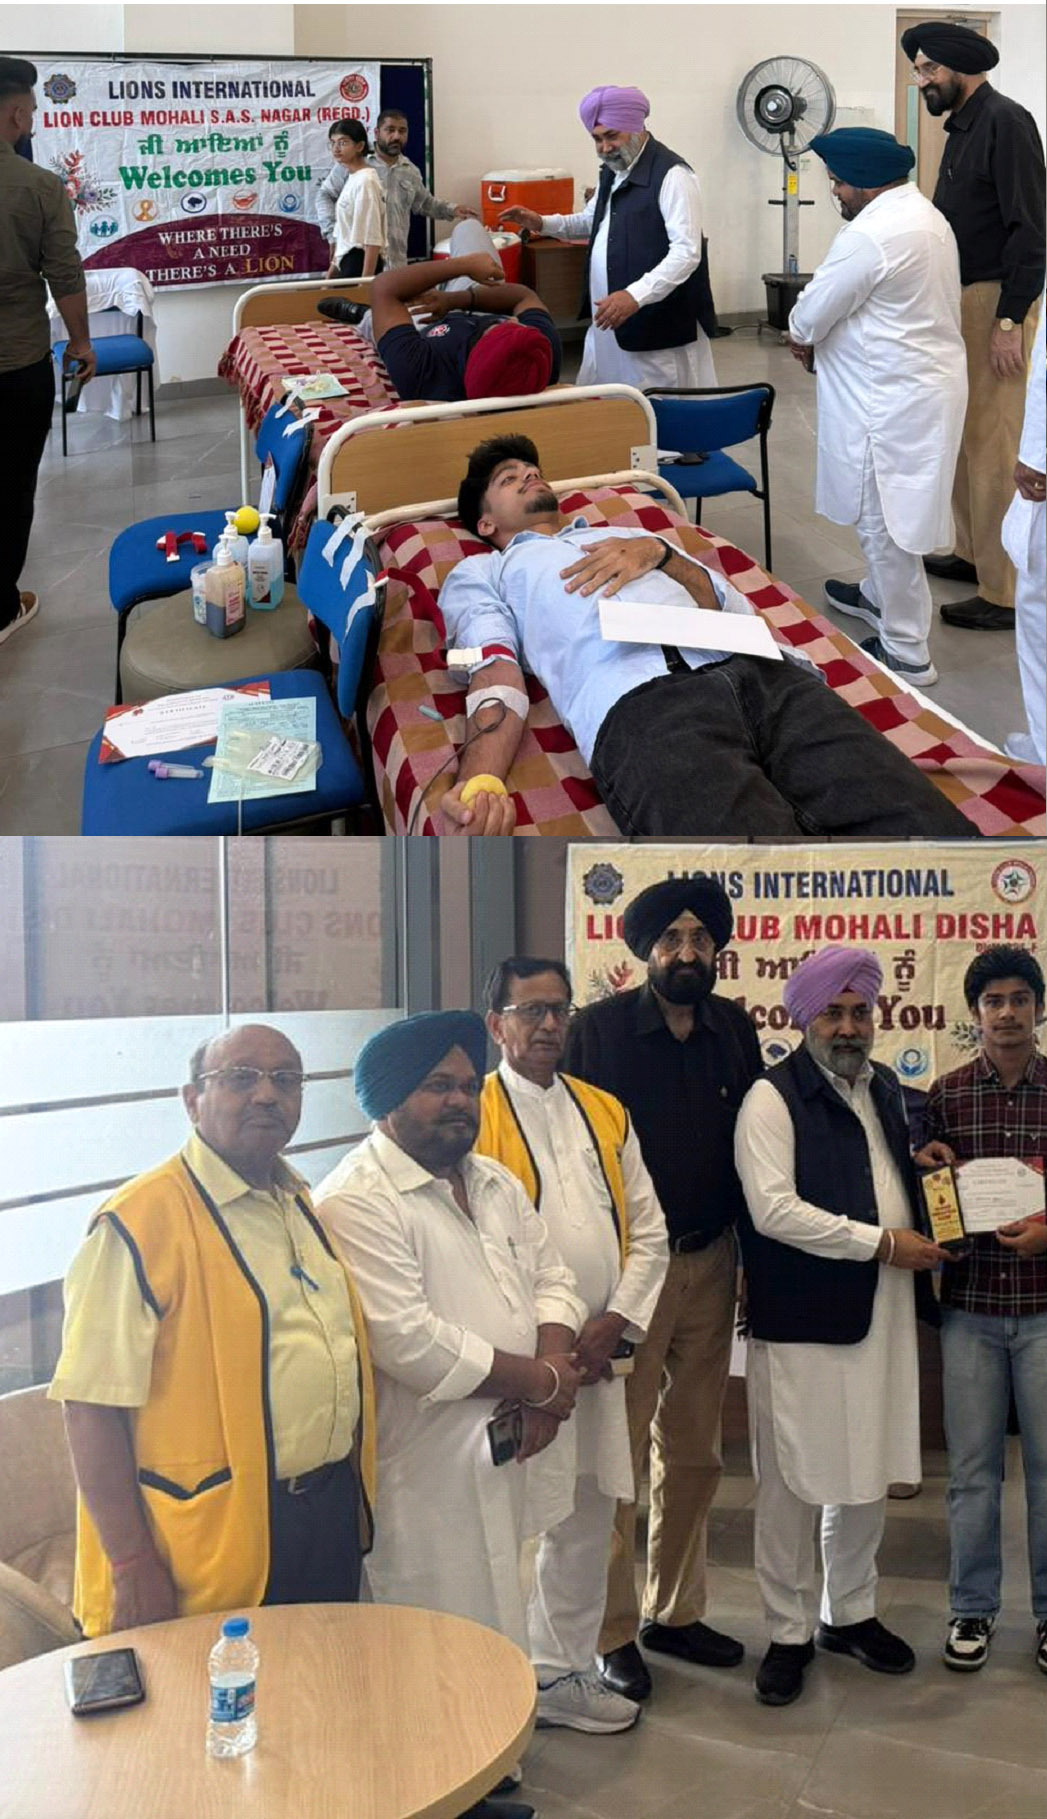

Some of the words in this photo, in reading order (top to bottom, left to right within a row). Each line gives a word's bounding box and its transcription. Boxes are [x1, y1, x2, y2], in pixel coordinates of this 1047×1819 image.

[109, 81, 166, 99] LIONS
[172, 80, 315, 99] INTERNATIONAL
[44, 111, 84, 128] LION
[90, 110, 134, 127] CLUB
[140, 110, 205, 125] MOHALI
[211, 109, 255, 124] S.A.S.
[261, 108, 311, 122] NAGAR
[317, 106, 370, 123] (REGD.)
[137, 133, 164, 155] ਜੀ
[273, 130, 290, 158] ਨੂੰ
[119, 165, 257, 190] Welcomes
[262, 161, 312, 183] You
[158, 228, 217, 245] WHERE
[219, 223, 283, 240] THERE'S
[193, 248, 205, 260] A
[209, 244, 251, 258] NEED
[146, 265, 217, 282] THERE'S
[224, 263, 236, 275] A
[246, 255, 295, 273] LION
[754, 869, 955, 898] INTERNATIONAL
[794, 914, 921, 940] MOHALI
[937, 912, 1037, 940] DISHA
[893, 949, 915, 992] ਨੂੰ
[877, 995, 946, 1031] You
